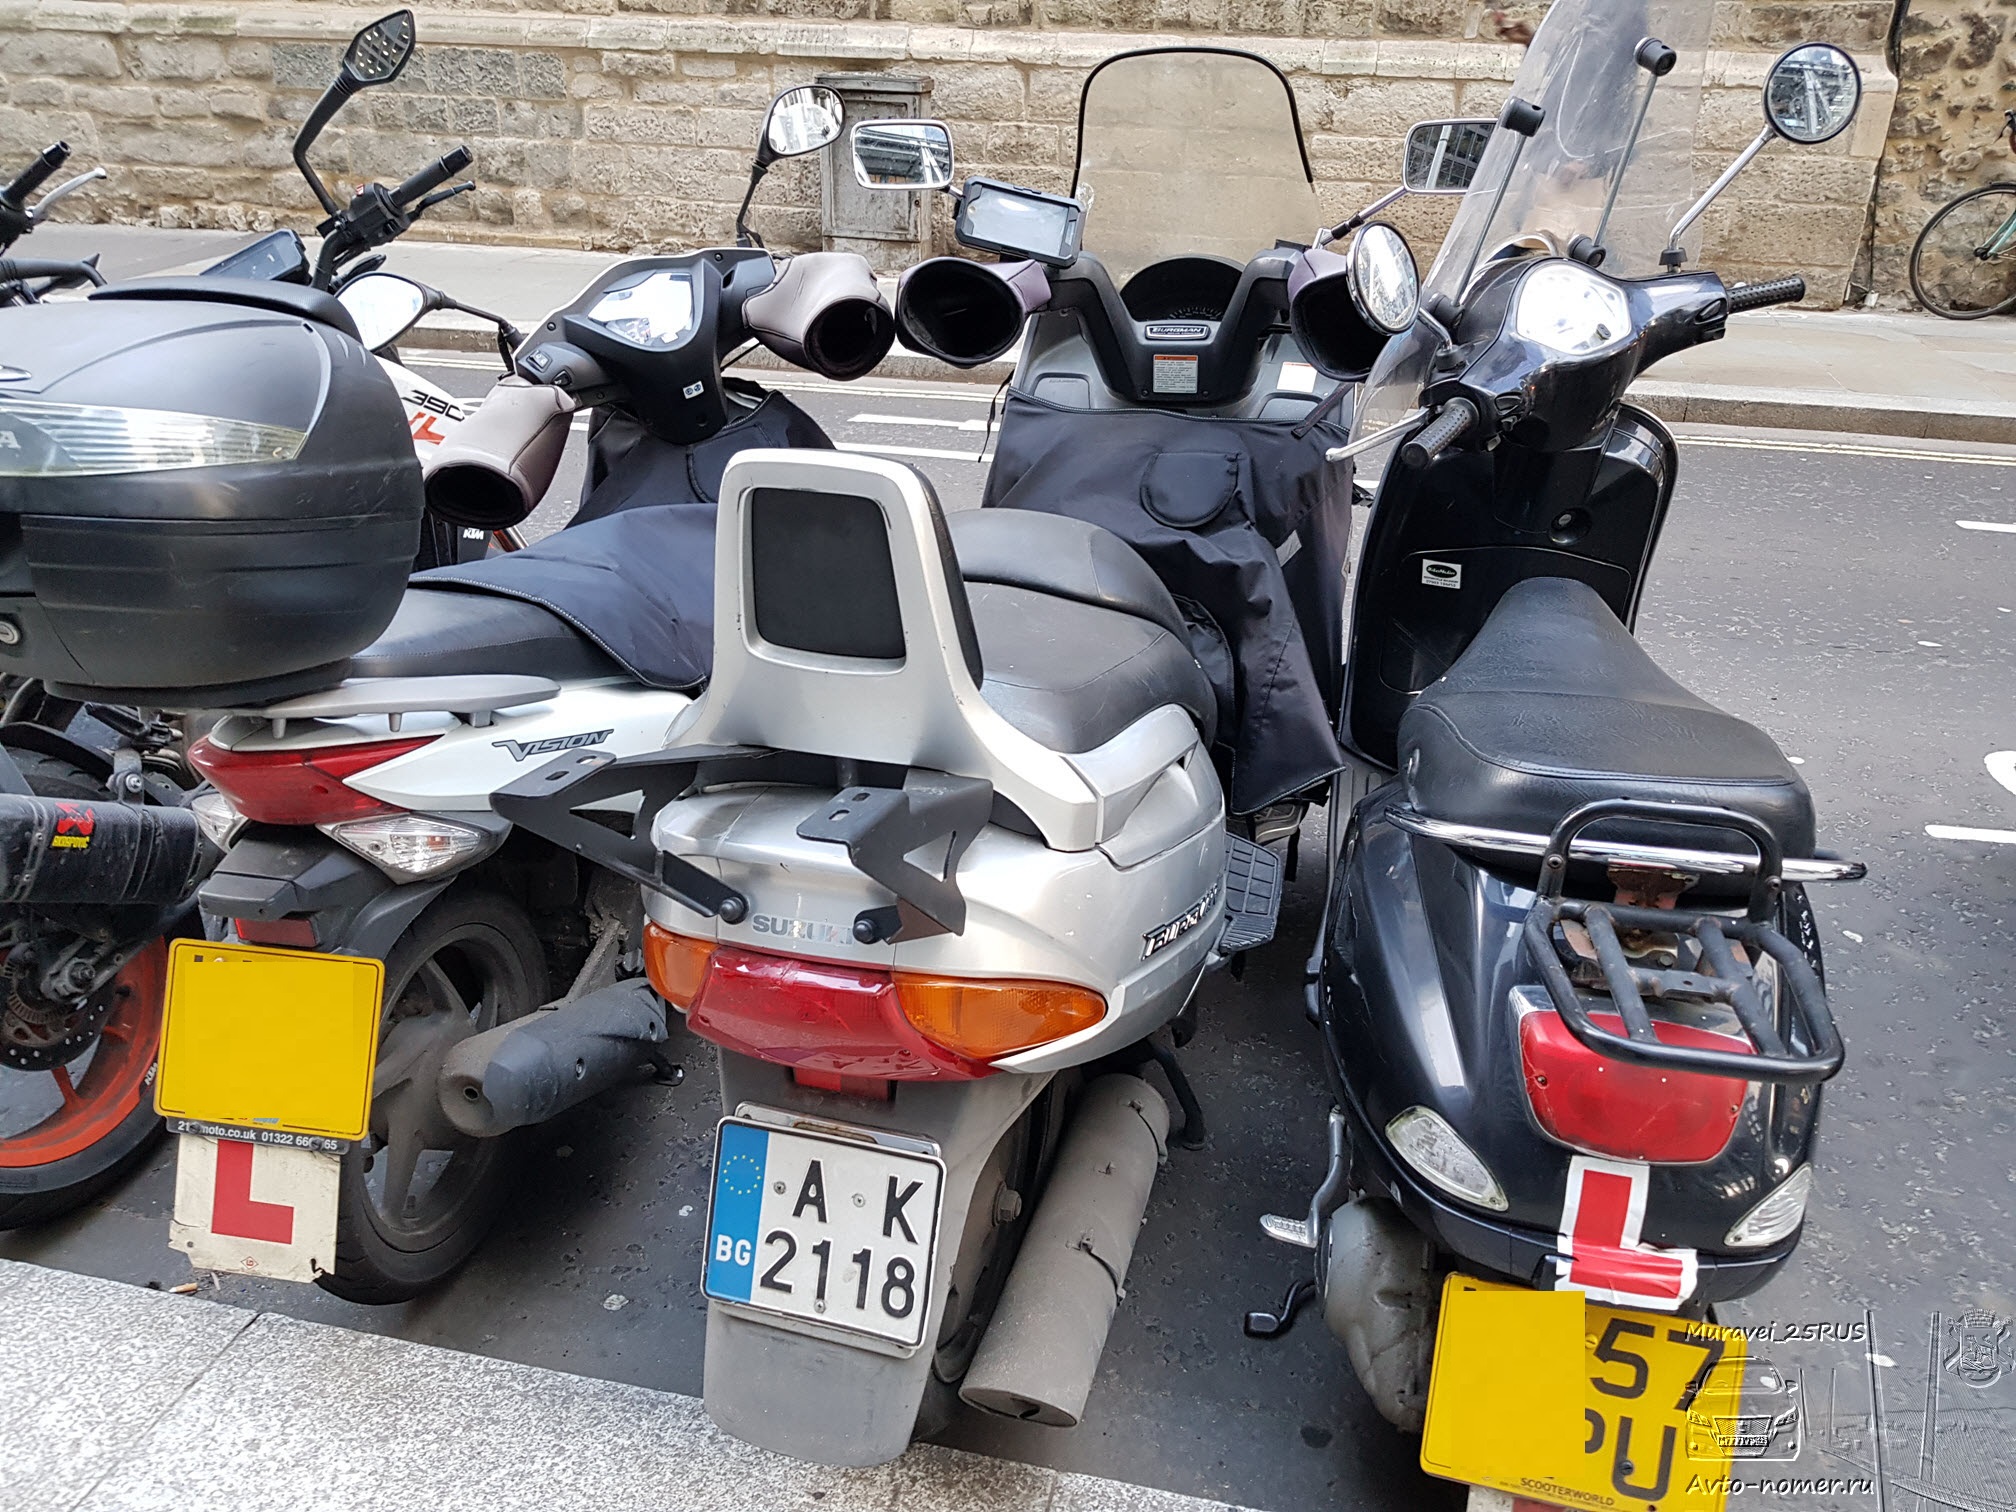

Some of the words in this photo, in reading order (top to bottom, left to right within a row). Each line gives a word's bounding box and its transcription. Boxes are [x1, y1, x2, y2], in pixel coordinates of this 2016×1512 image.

[400, 389, 465, 422] 390
[462, 527, 485, 540] KTM
[491, 728, 615, 762] VISION
[752, 914, 853, 945] SUZUKI
[261, 1131, 293, 1145] 01322
[792, 1159, 829, 1224] A
[882, 1175, 924, 1245] K
[715, 1233, 752, 1267] BG
[759, 1229, 916, 1319] 2118
[1520, 1477, 1616, 1507] SCOOTERWORLD
